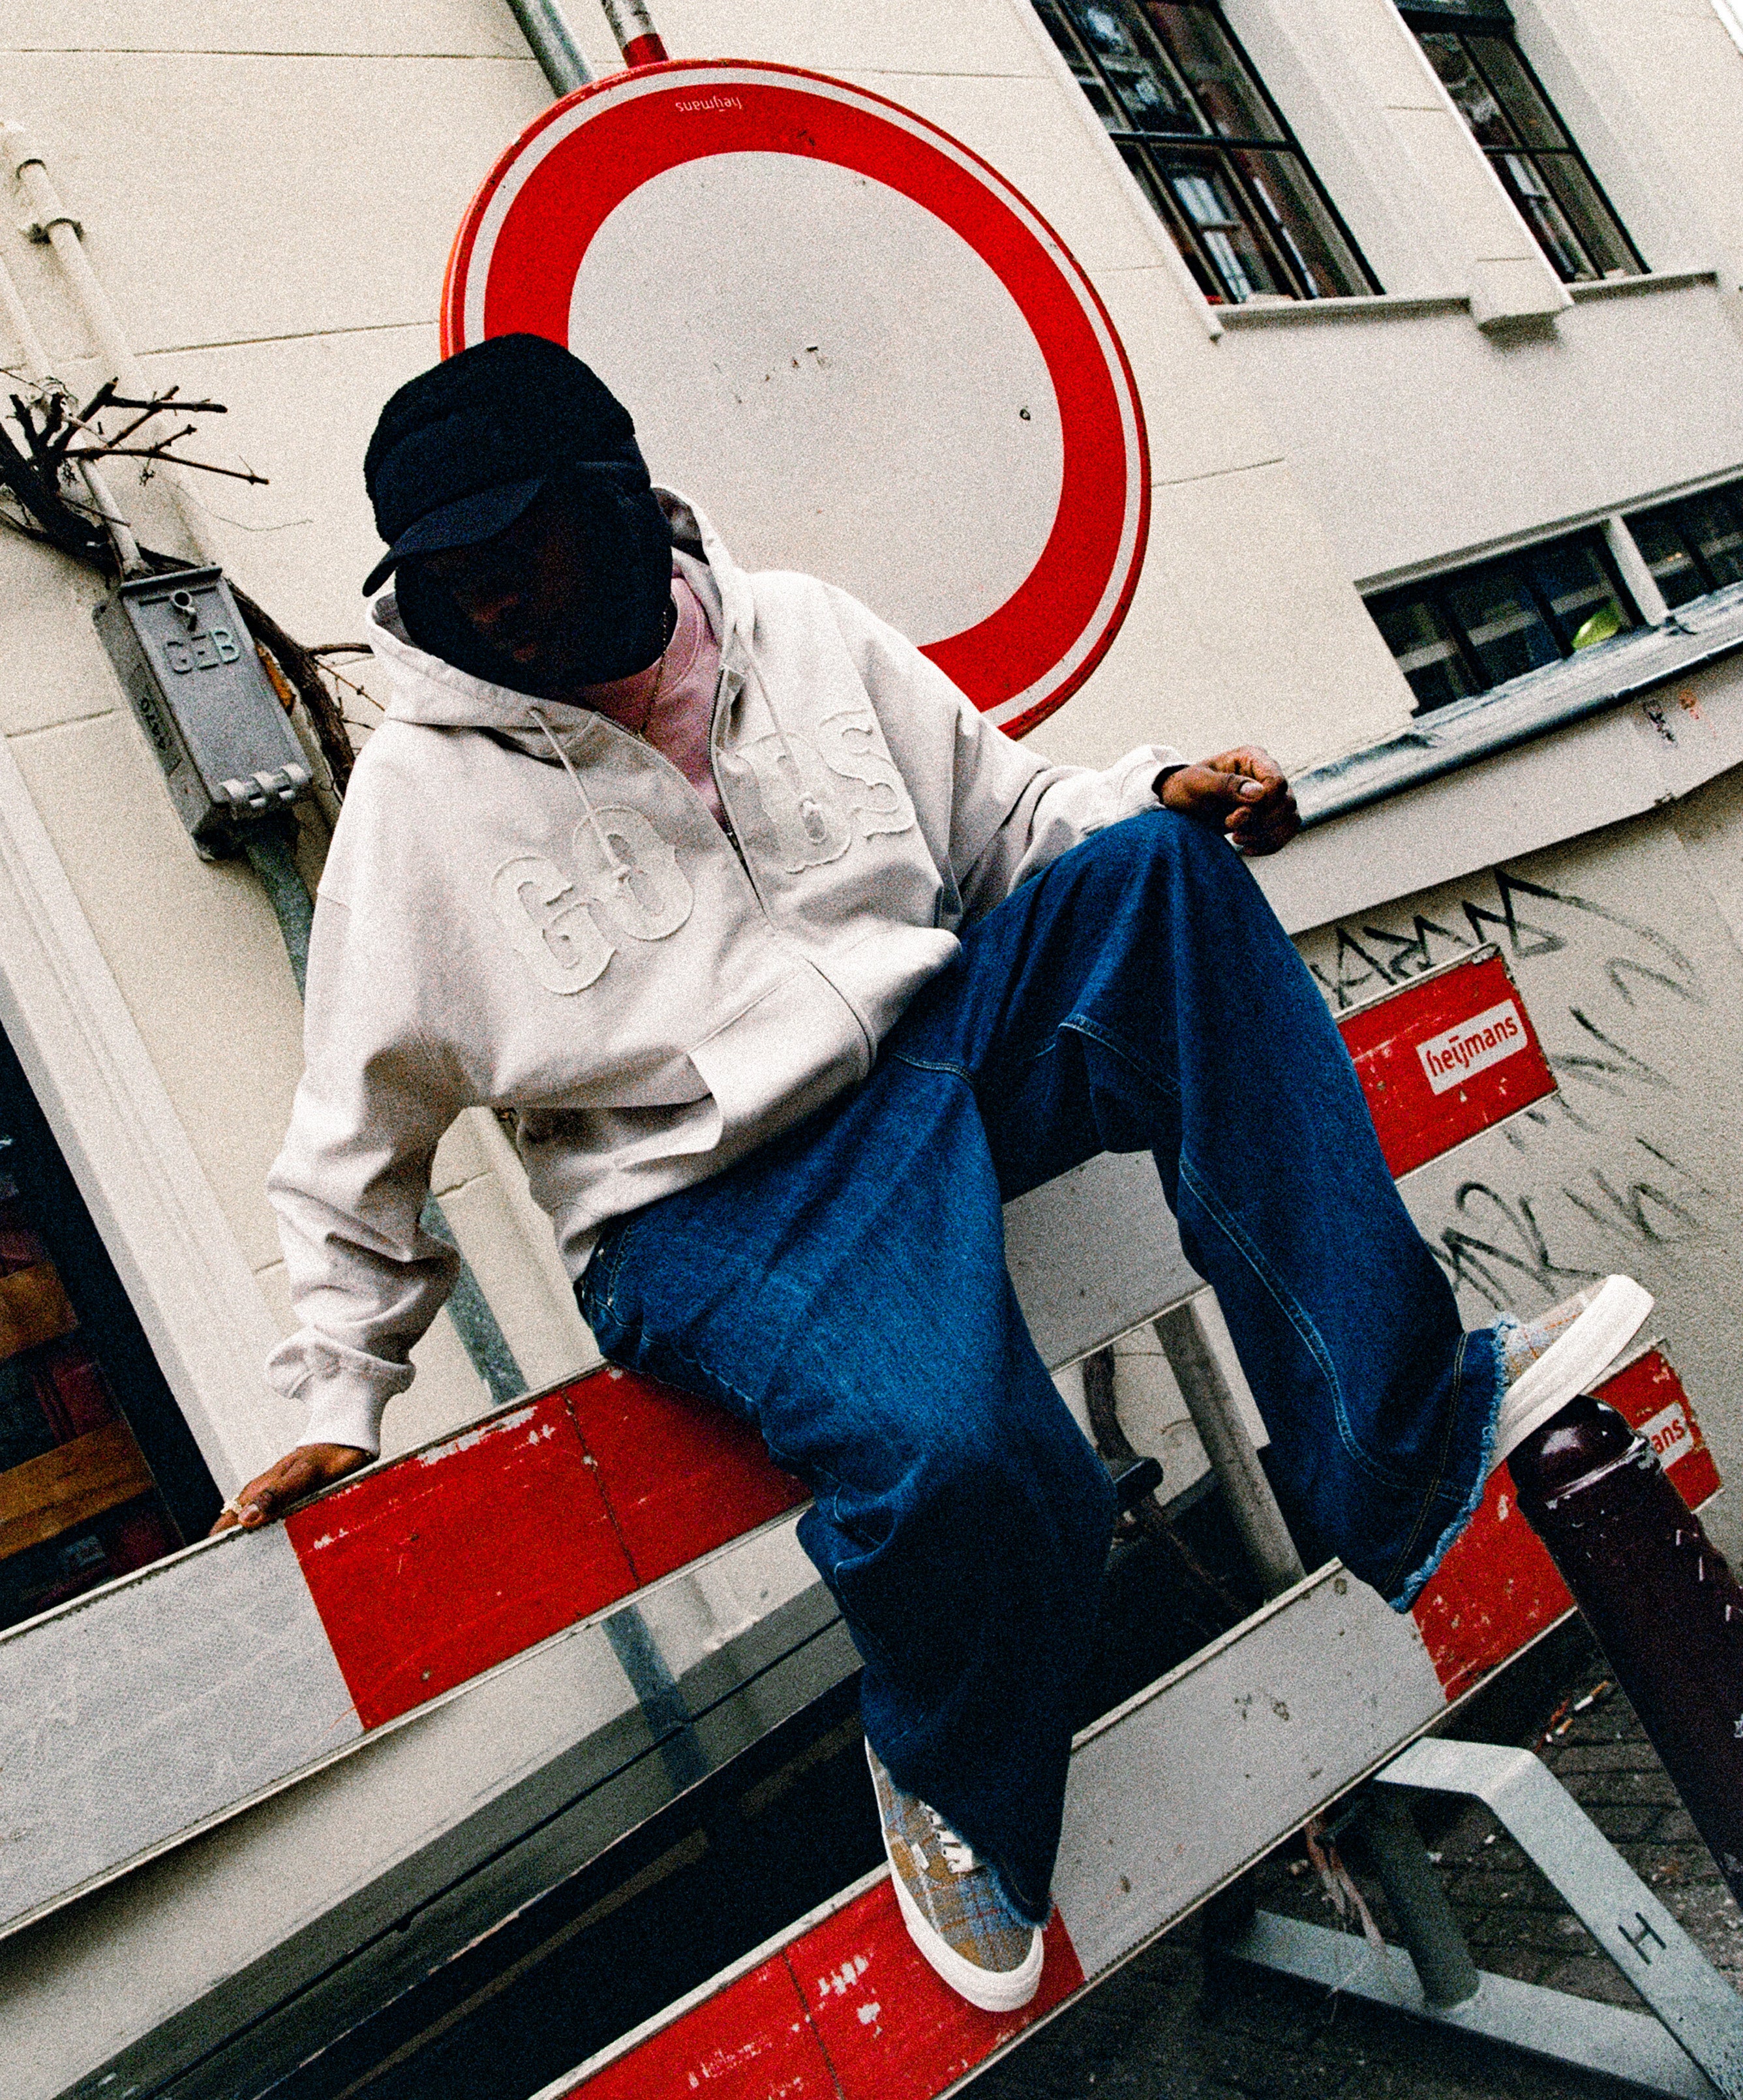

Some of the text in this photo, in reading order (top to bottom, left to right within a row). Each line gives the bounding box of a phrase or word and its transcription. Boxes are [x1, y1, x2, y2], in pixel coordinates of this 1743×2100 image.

[675, 95, 742, 112] heijmans
[165, 630, 240, 674] GEB
[1426, 1017, 1519, 1077] heijmans
